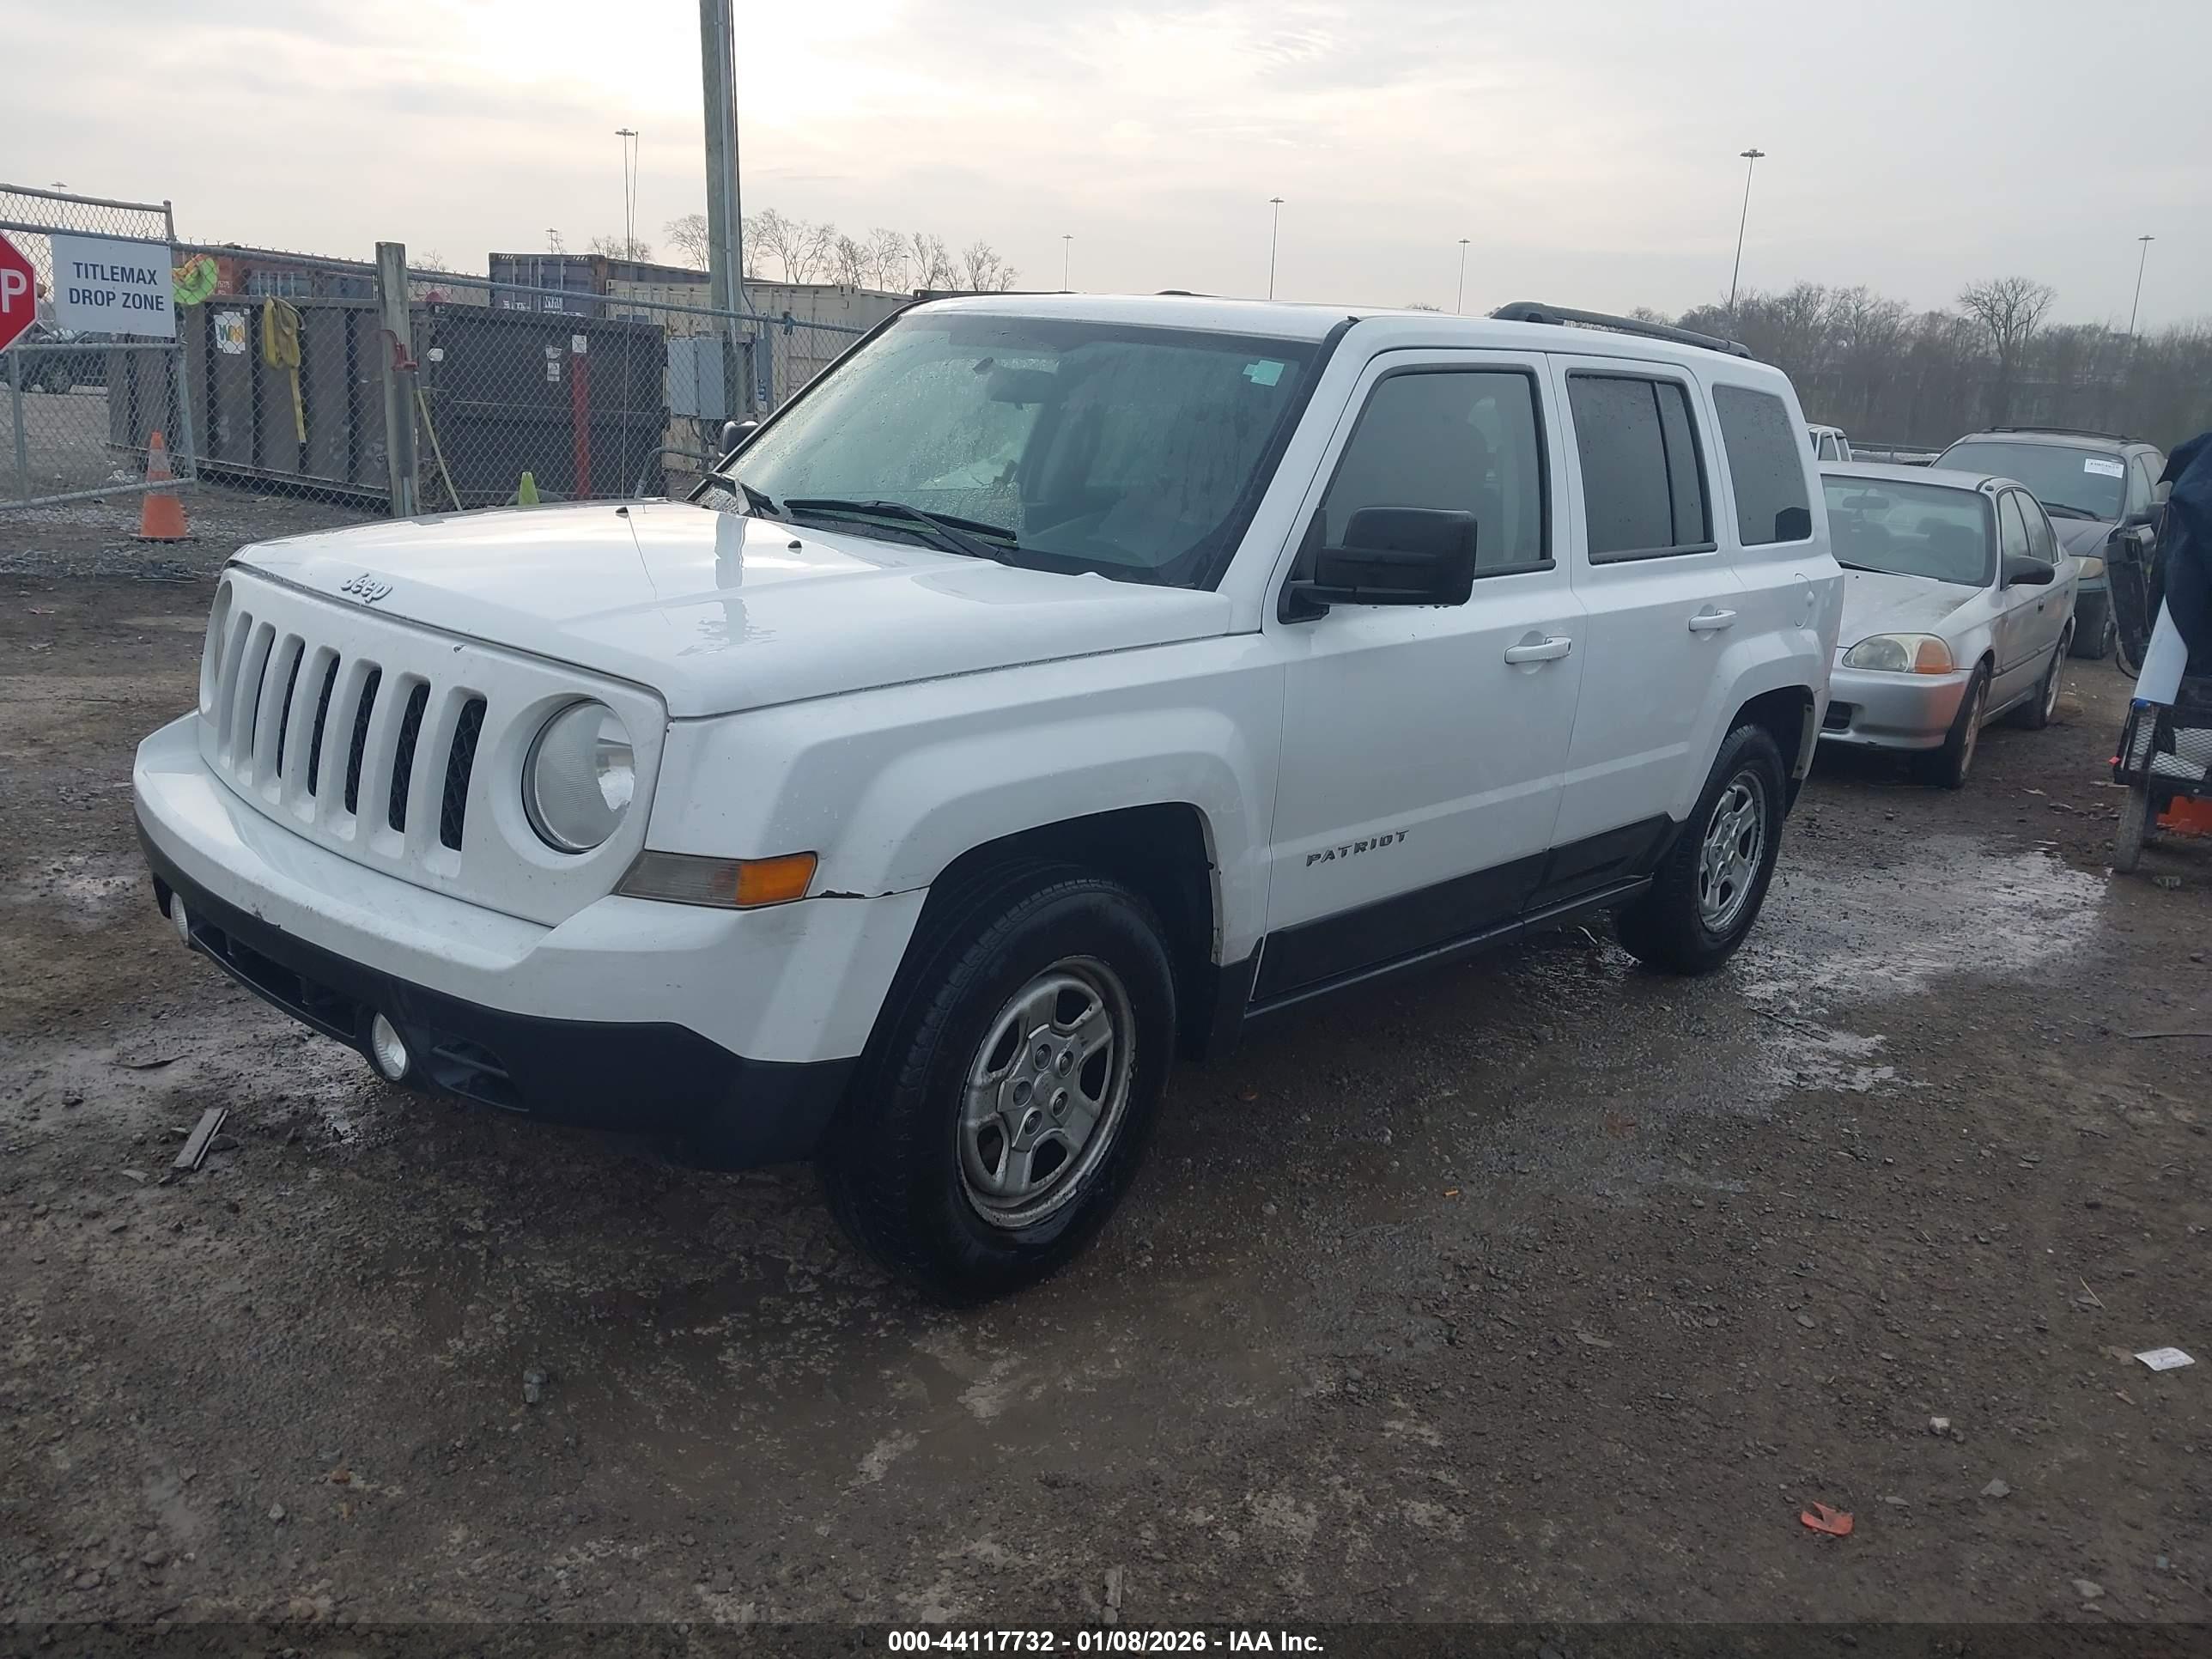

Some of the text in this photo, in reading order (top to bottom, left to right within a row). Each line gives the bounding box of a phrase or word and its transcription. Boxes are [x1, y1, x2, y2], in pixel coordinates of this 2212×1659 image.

[72, 261, 158, 285] TITLEMAX
[69, 287, 165, 311] DROP ZONE
[340, 573, 393, 604] Jeep
[1305, 830, 1410, 867] PATRIOT
